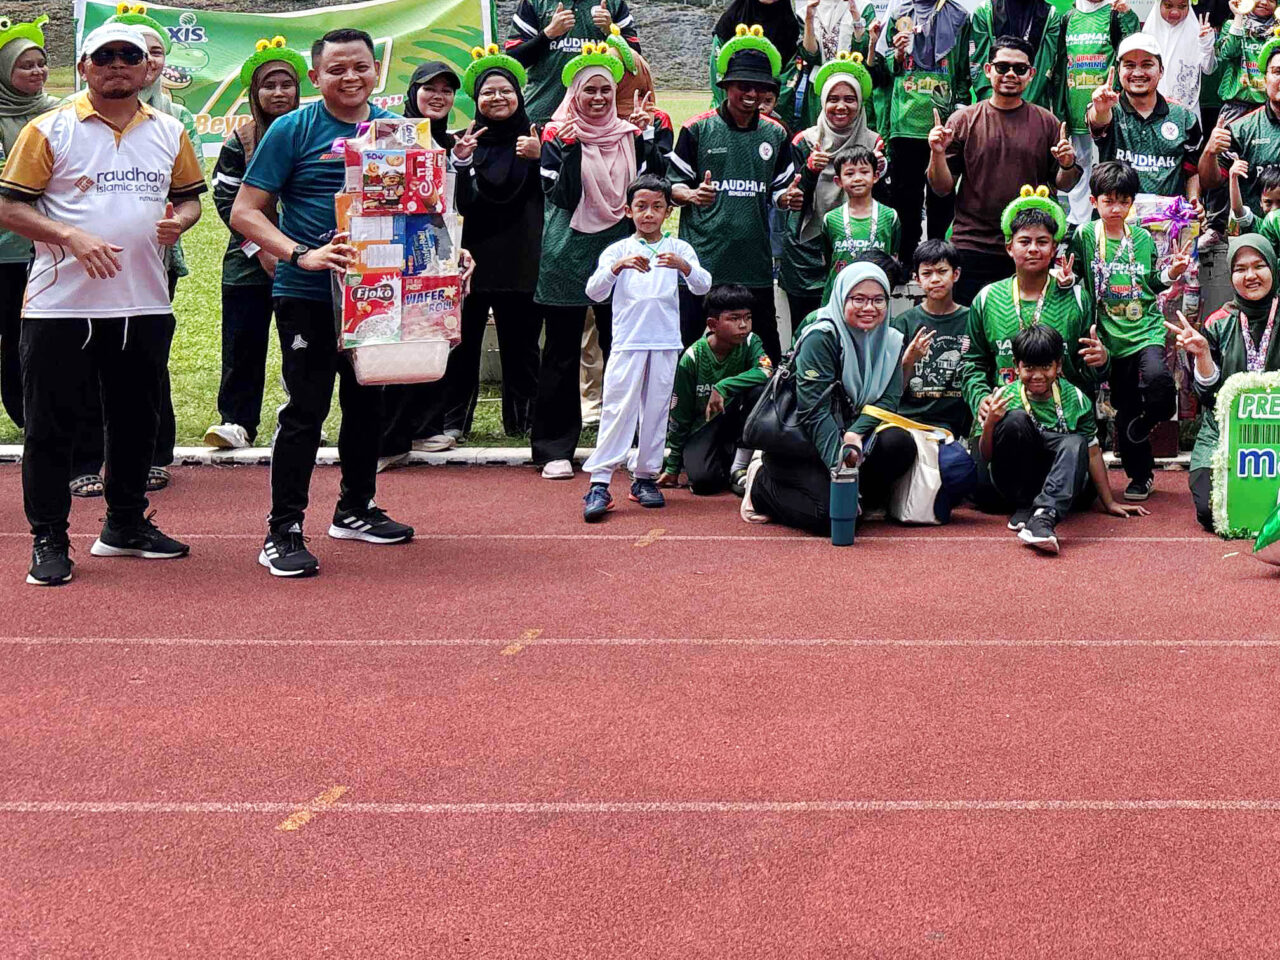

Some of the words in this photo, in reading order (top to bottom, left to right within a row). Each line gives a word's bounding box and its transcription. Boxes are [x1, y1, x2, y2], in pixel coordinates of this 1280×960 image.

[96, 167, 165, 184] raudhah
[96, 182, 133, 193] islamic
[405, 289, 446, 305] WAFER
[428, 300, 454, 312] ROLL
